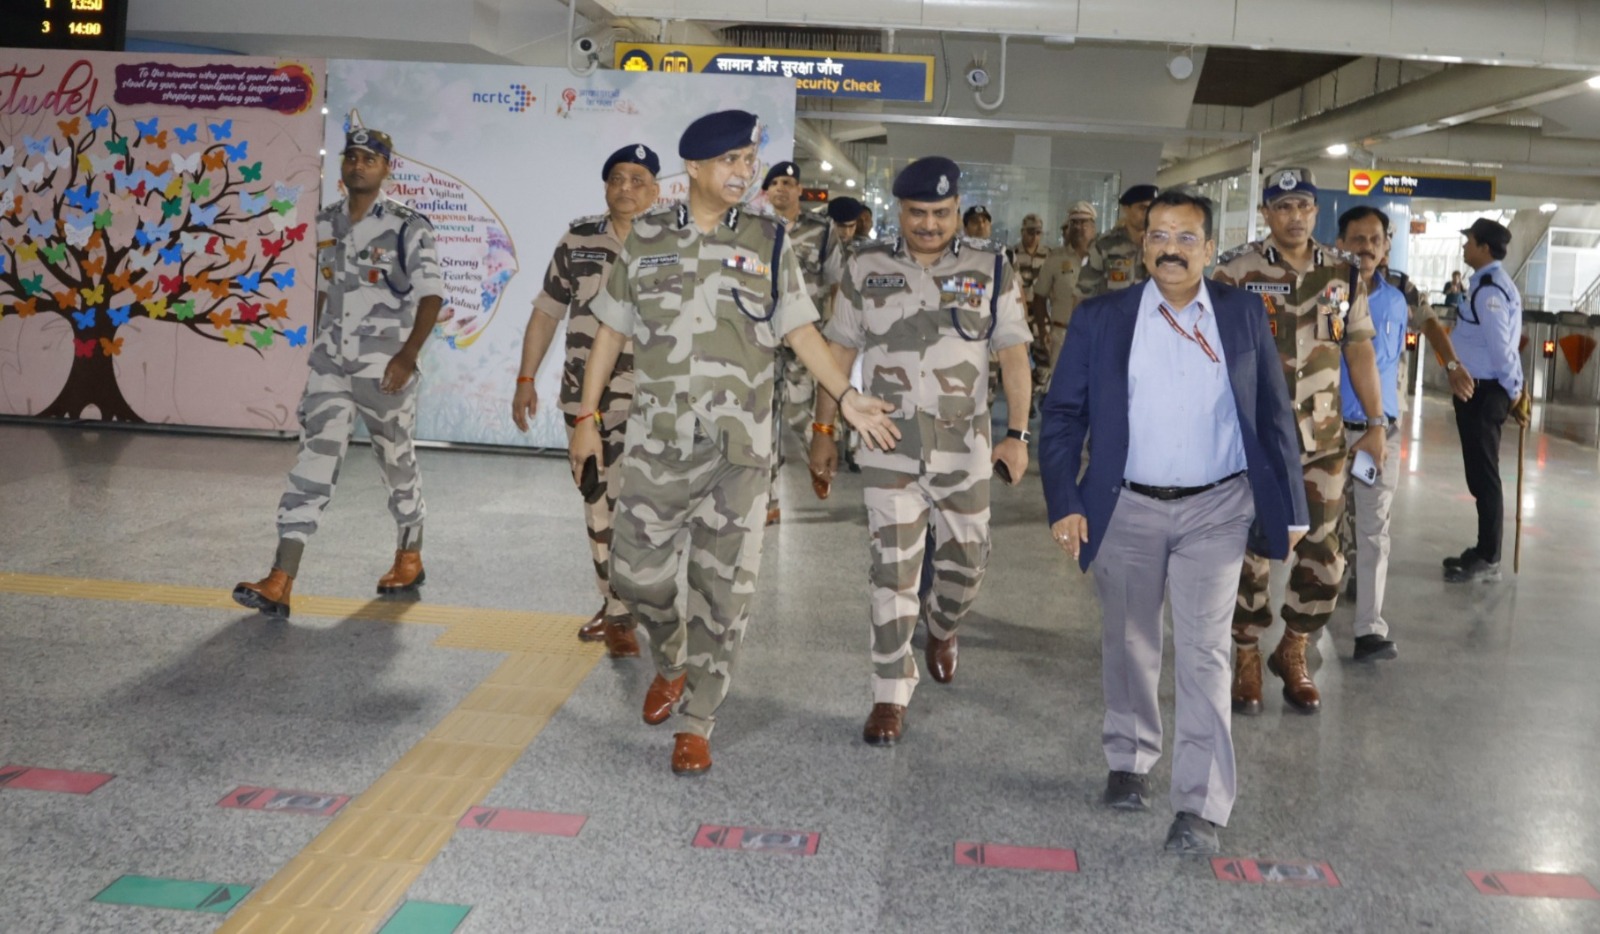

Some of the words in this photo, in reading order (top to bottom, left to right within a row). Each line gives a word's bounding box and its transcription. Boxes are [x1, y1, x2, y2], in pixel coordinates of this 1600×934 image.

[70, 0, 103, 10] 13:50
[41, 20, 50, 33] 3
[68, 22, 102, 34] 14:00
[717, 57, 752, 72] सामान
[756, 56, 778, 73] और
[781, 60, 814, 78] सुरक्षा
[139, 67, 150, 78] To
[150, 68, 165, 78] the
[198, 70, 217, 80] who
[214, 72, 246, 84] paved
[246, 74, 268, 82] your
[0, 59, 98, 117] tude!
[122, 78, 146, 88] stood
[146, 80, 158, 90] by
[179, 81, 198, 90] and
[199, 82, 236, 91] continue
[238, 82, 247, 92] to
[248, 83, 279, 94] inspire
[796, 78, 839, 93] ecurity
[843, 79, 881, 92] Check
[472, 92, 511, 104] ncrtc
[390, 158, 404, 170] fe
[422, 173, 462, 190] Aware
[386, 184, 425, 196] Alert
[429, 188, 464, 200] Vigilant
[1394, 186, 1413, 196] Entry
[428, 214, 466, 222] rageous
[434, 224, 474, 232] owered
[434, 234, 482, 244] dependent
[440, 256, 478, 270] Strong
[441, 270, 482, 281] Fearless
[450, 296, 480, 311] Valued
